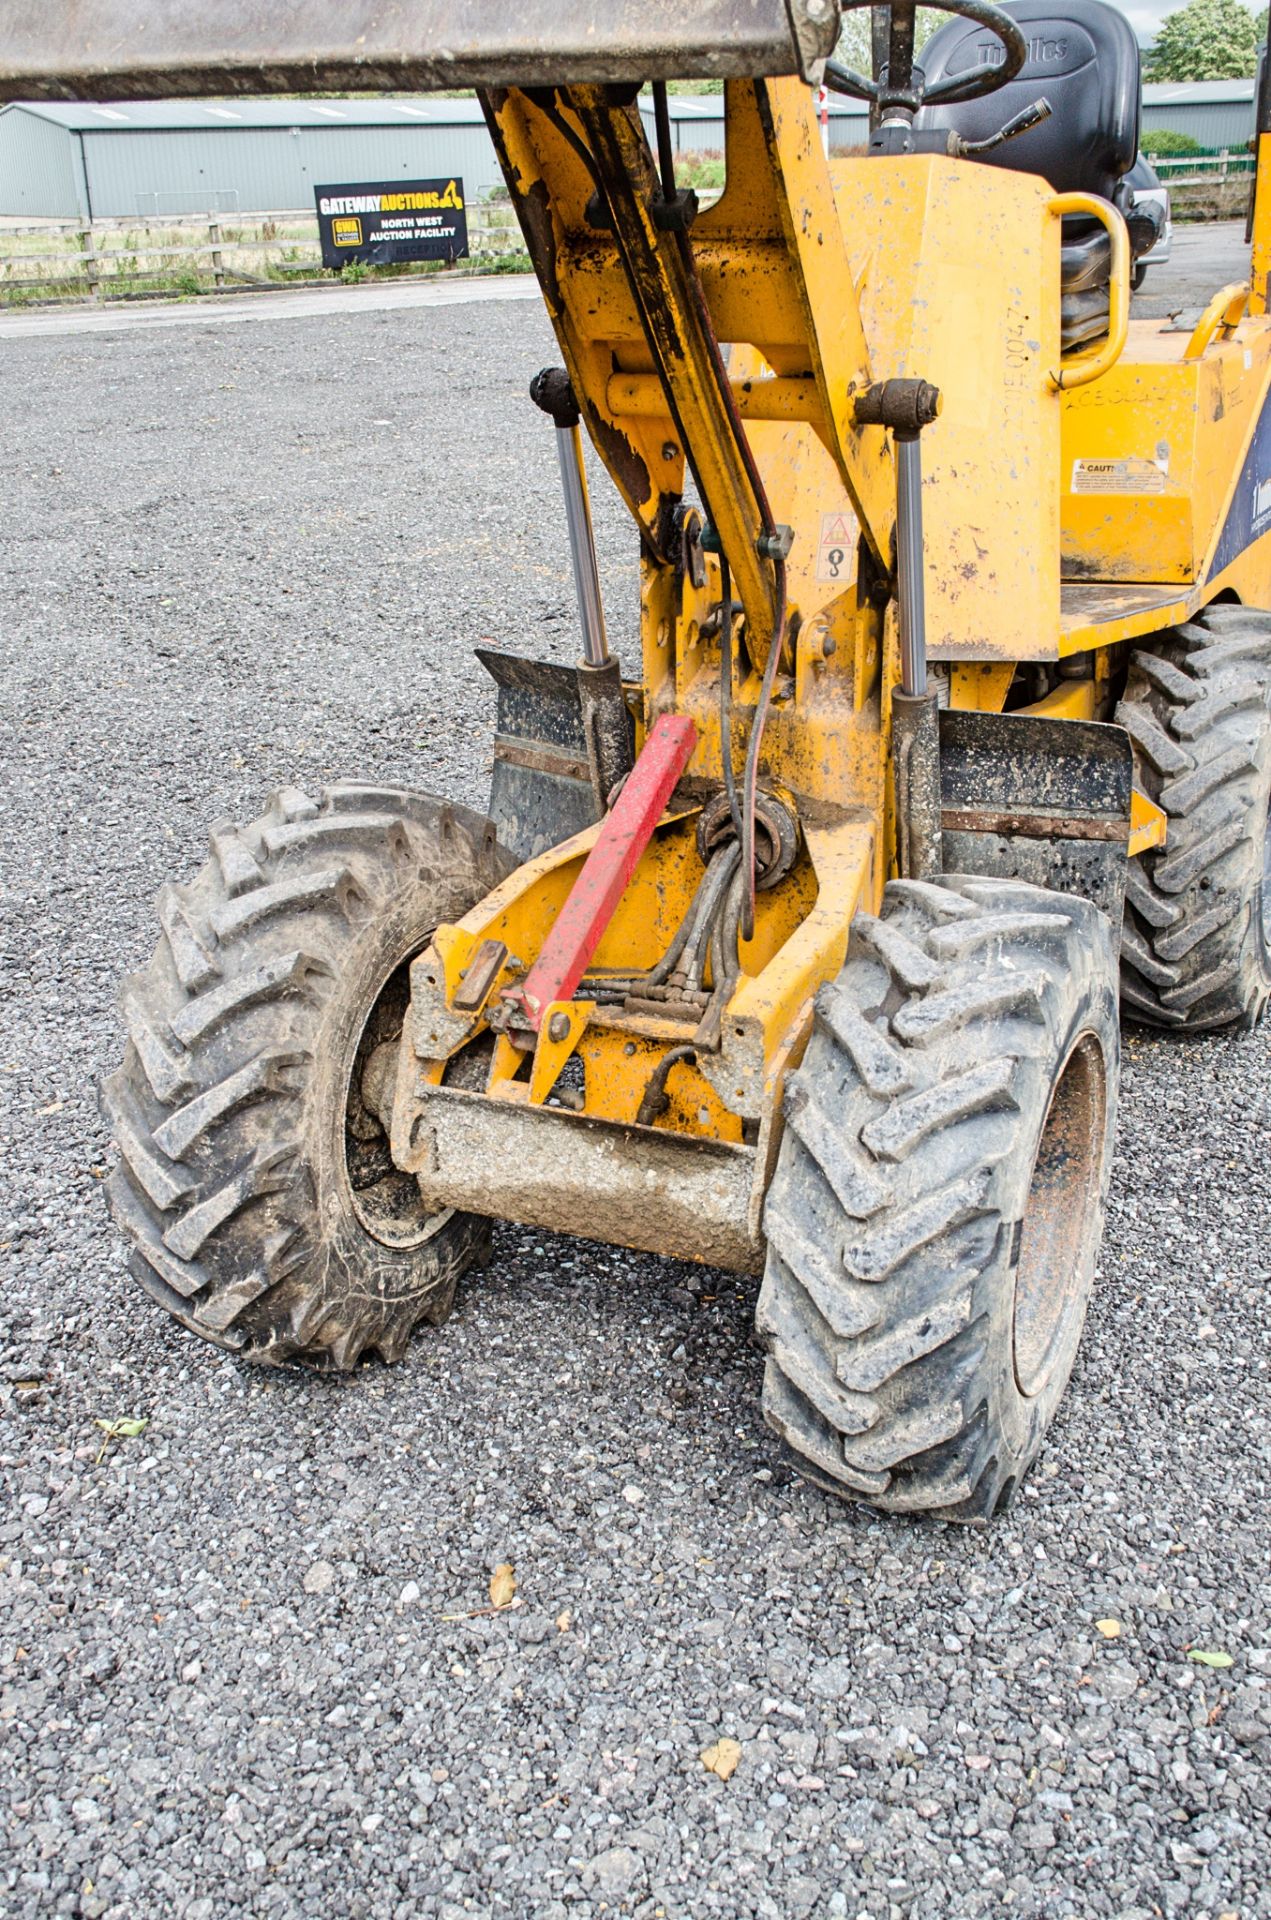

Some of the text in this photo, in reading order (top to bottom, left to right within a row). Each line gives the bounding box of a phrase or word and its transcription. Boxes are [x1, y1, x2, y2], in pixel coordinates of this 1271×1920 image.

[335, 220, 358, 232] GWA
[381, 216, 443, 229] NORTH WEST
[369, 229, 412, 242] AUCTION
[414, 227, 456, 239] FACILITY
